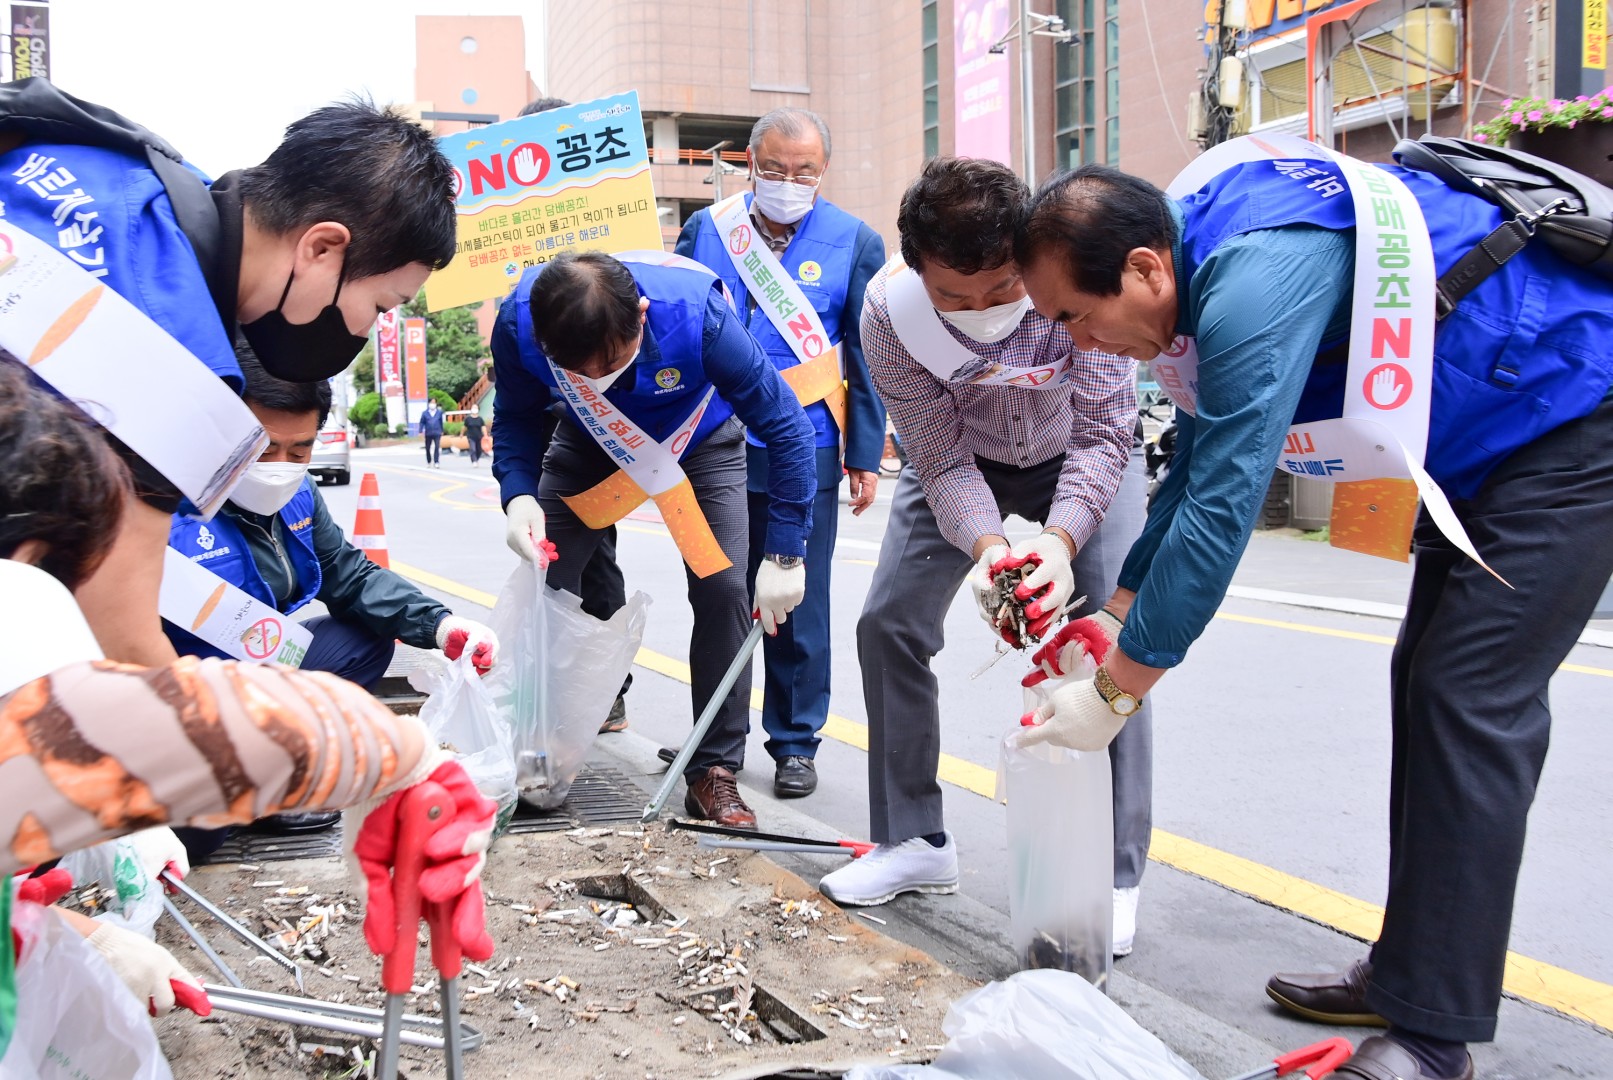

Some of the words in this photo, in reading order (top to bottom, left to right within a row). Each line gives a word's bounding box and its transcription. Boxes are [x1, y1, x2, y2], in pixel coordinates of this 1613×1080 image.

[467, 142, 551, 196] NO
[556, 126, 631, 173] 꽁초
[455, 228, 523, 254] 미세플라스틱이
[526, 224, 546, 238] 되어
[549, 214, 580, 232] 물고기
[583, 206, 614, 223] 먹이가
[617, 199, 649, 217] 됩니다
[478, 214, 508, 232] 바다로
[512, 206, 541, 225] 흘러간
[545, 196, 589, 217] 담배꽁초!
[468, 246, 508, 268] 담배꽁초
[512, 243, 533, 258] 없는
[535, 231, 576, 252] 아름다운
[579, 224, 611, 241] 해운대
[1358, 168, 1411, 309] 담배꽁초
[742, 249, 798, 320] 담배꽁초
[602, 438, 636, 465] 만들기
[607, 418, 646, 450] 없는
[1283, 458, 1345, 477] 만들기
